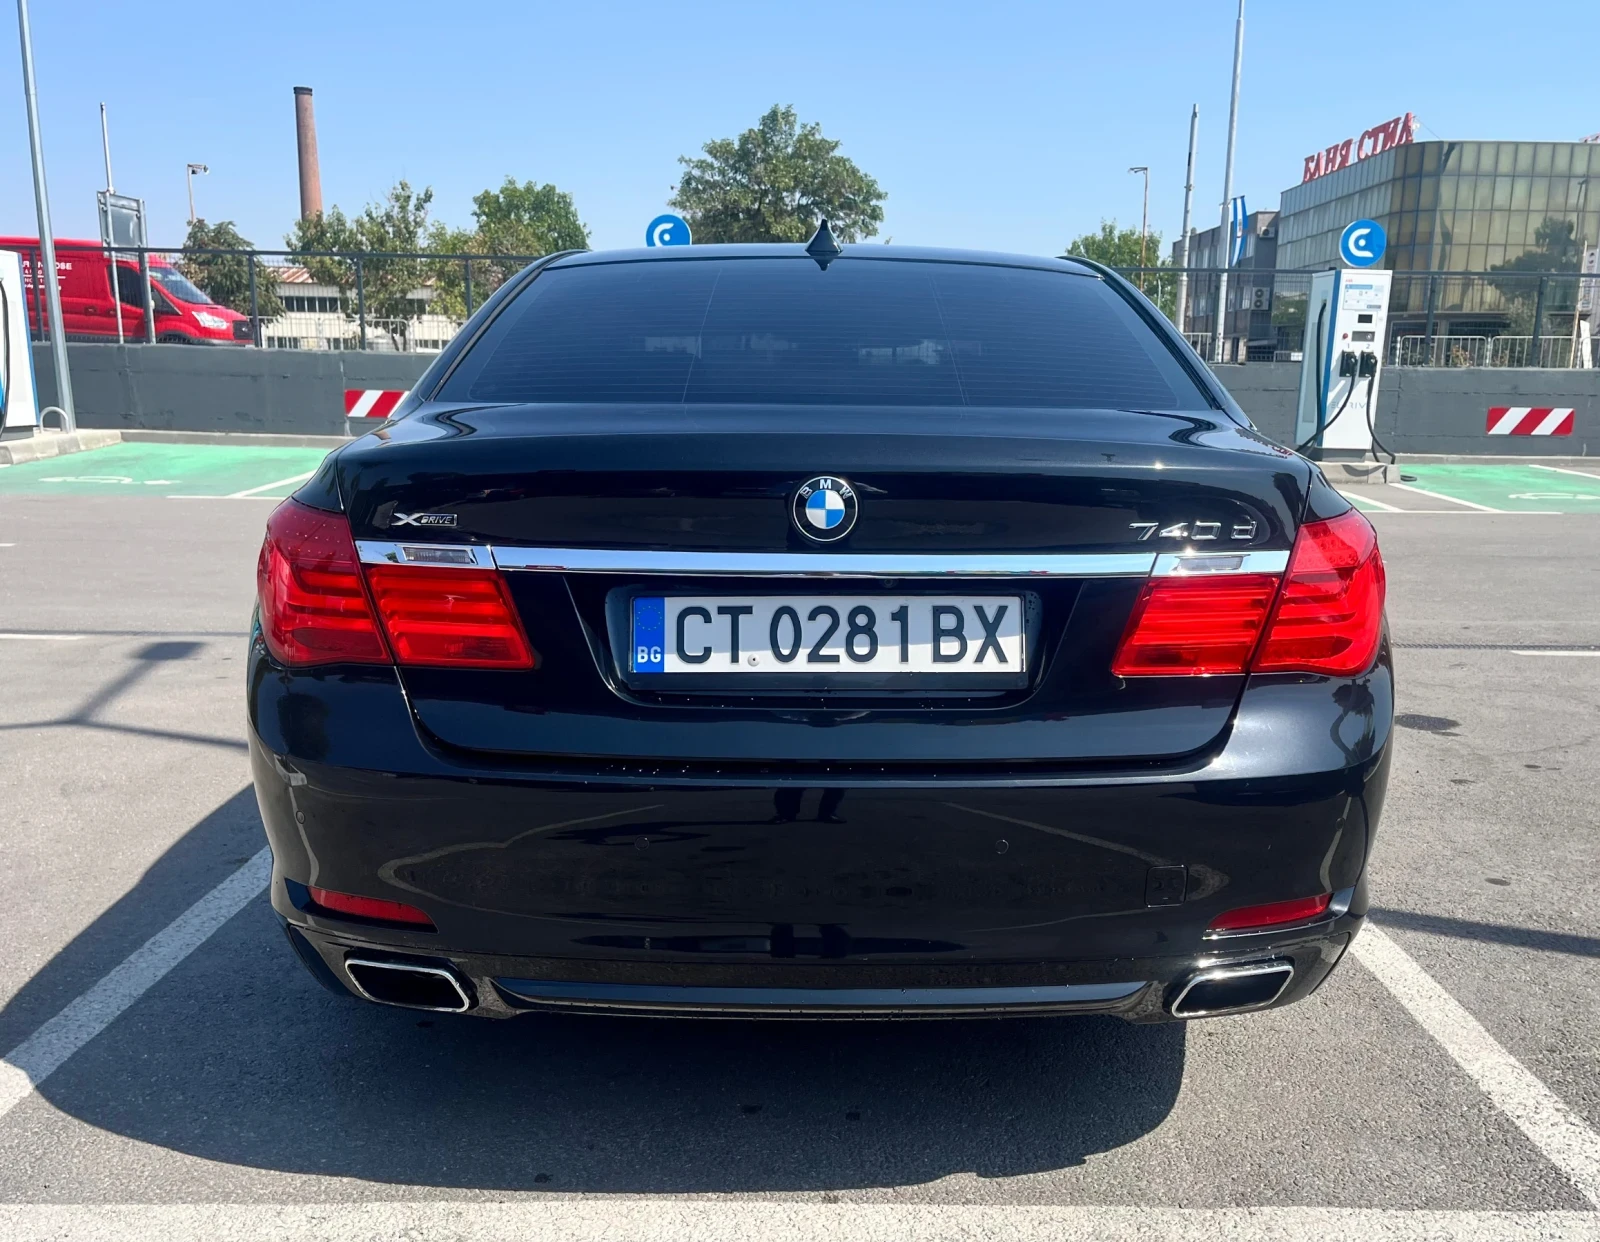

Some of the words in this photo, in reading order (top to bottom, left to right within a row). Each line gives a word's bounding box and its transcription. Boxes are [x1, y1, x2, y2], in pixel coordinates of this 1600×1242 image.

[1303, 138, 1353, 183] БАНЯ
[1357, 112, 1413, 161] СТИЛ
[800, 479, 853, 499] BMW
[1129, 520, 1221, 540] 740
[676, 606, 753, 663] CT
[769, 606, 909, 663] 0281
[932, 606, 1009, 663] BX
[637, 646, 662, 663] BG
